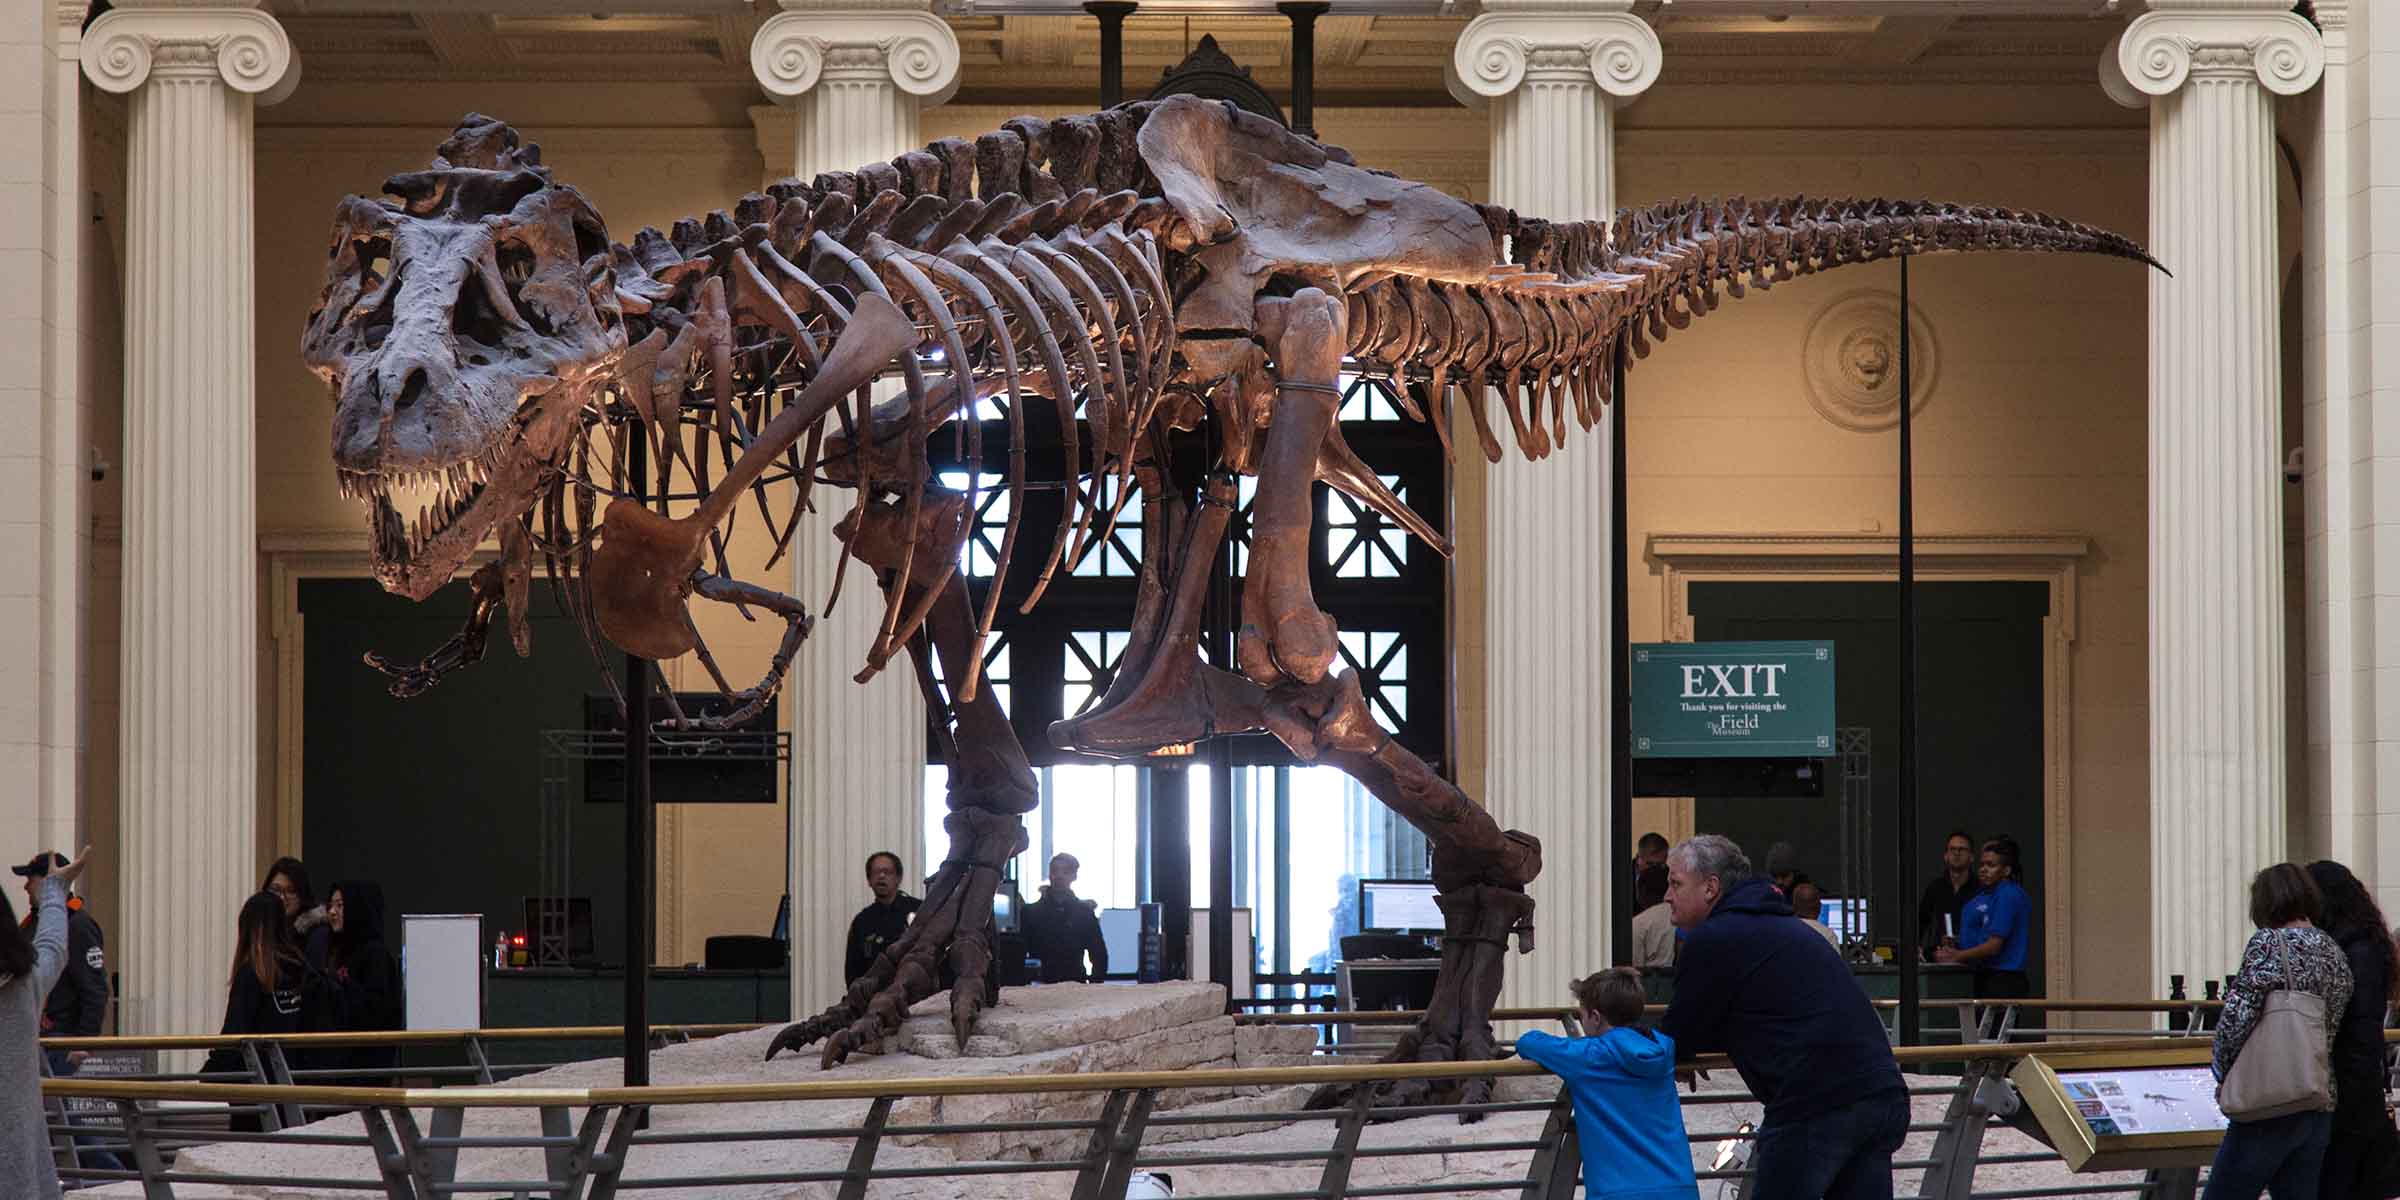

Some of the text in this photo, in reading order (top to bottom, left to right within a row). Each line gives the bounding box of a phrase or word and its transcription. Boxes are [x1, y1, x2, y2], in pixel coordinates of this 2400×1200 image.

[1680, 664, 1786, 697] EXIT
[1681, 702, 1787, 712] Thank you for visiting the
[1720, 714, 1759, 728] Field
[1712, 728, 1751, 736] Museum
